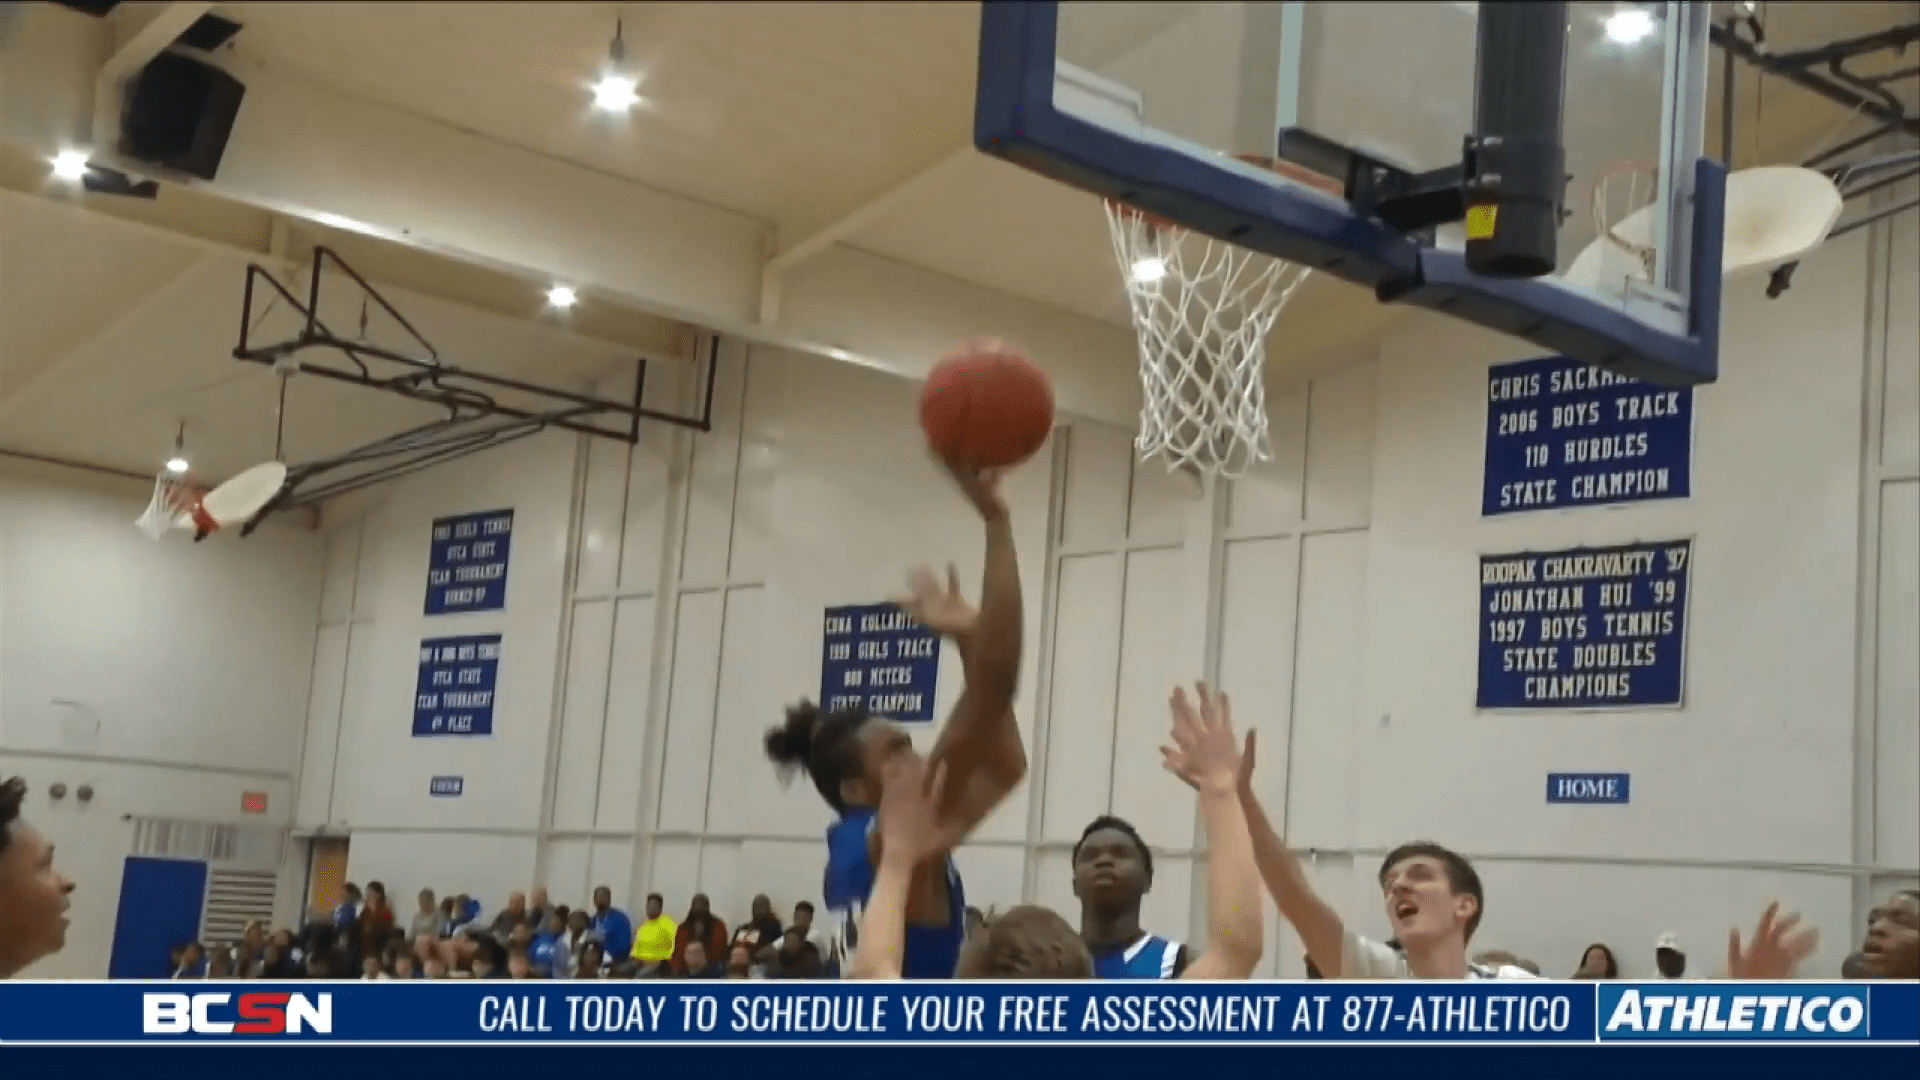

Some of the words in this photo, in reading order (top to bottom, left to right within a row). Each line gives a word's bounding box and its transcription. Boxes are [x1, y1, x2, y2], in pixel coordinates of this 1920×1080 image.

[1490, 373, 1541, 401] CHRIS
[1498, 410, 1538, 436] 2006
[1552, 401, 1600, 429] BOYS
[1616, 391, 1679, 421] TRACK
[1525, 444, 1549, 468] 110
[1564, 432, 1648, 464] HURDLES
[1500, 479, 1557, 507] STATE
[1571, 467, 1669, 500] CHAMPION
[1543, 551, 1655, 581] CHAKRAVARTY
[1489, 584, 1584, 614] JONATHAN
[1599, 582, 1632, 607] HUI
[1649, 580, 1675, 603] '99
[1490, 617, 1526, 642] 1997
[1540, 614, 1587, 642] BOYS
[1603, 611, 1674, 636] TENNIS
[858, 641, 888, 660] GIRLS
[898, 637, 934, 658] TRACK
[1502, 645, 1558, 672] STATE
[1573, 641, 1656, 669] DOUBLES
[1525, 673, 1630, 700] CHAMPIONS
[868, 690, 923, 714] CHAMPION
[1558, 778, 1619, 798] HOME
